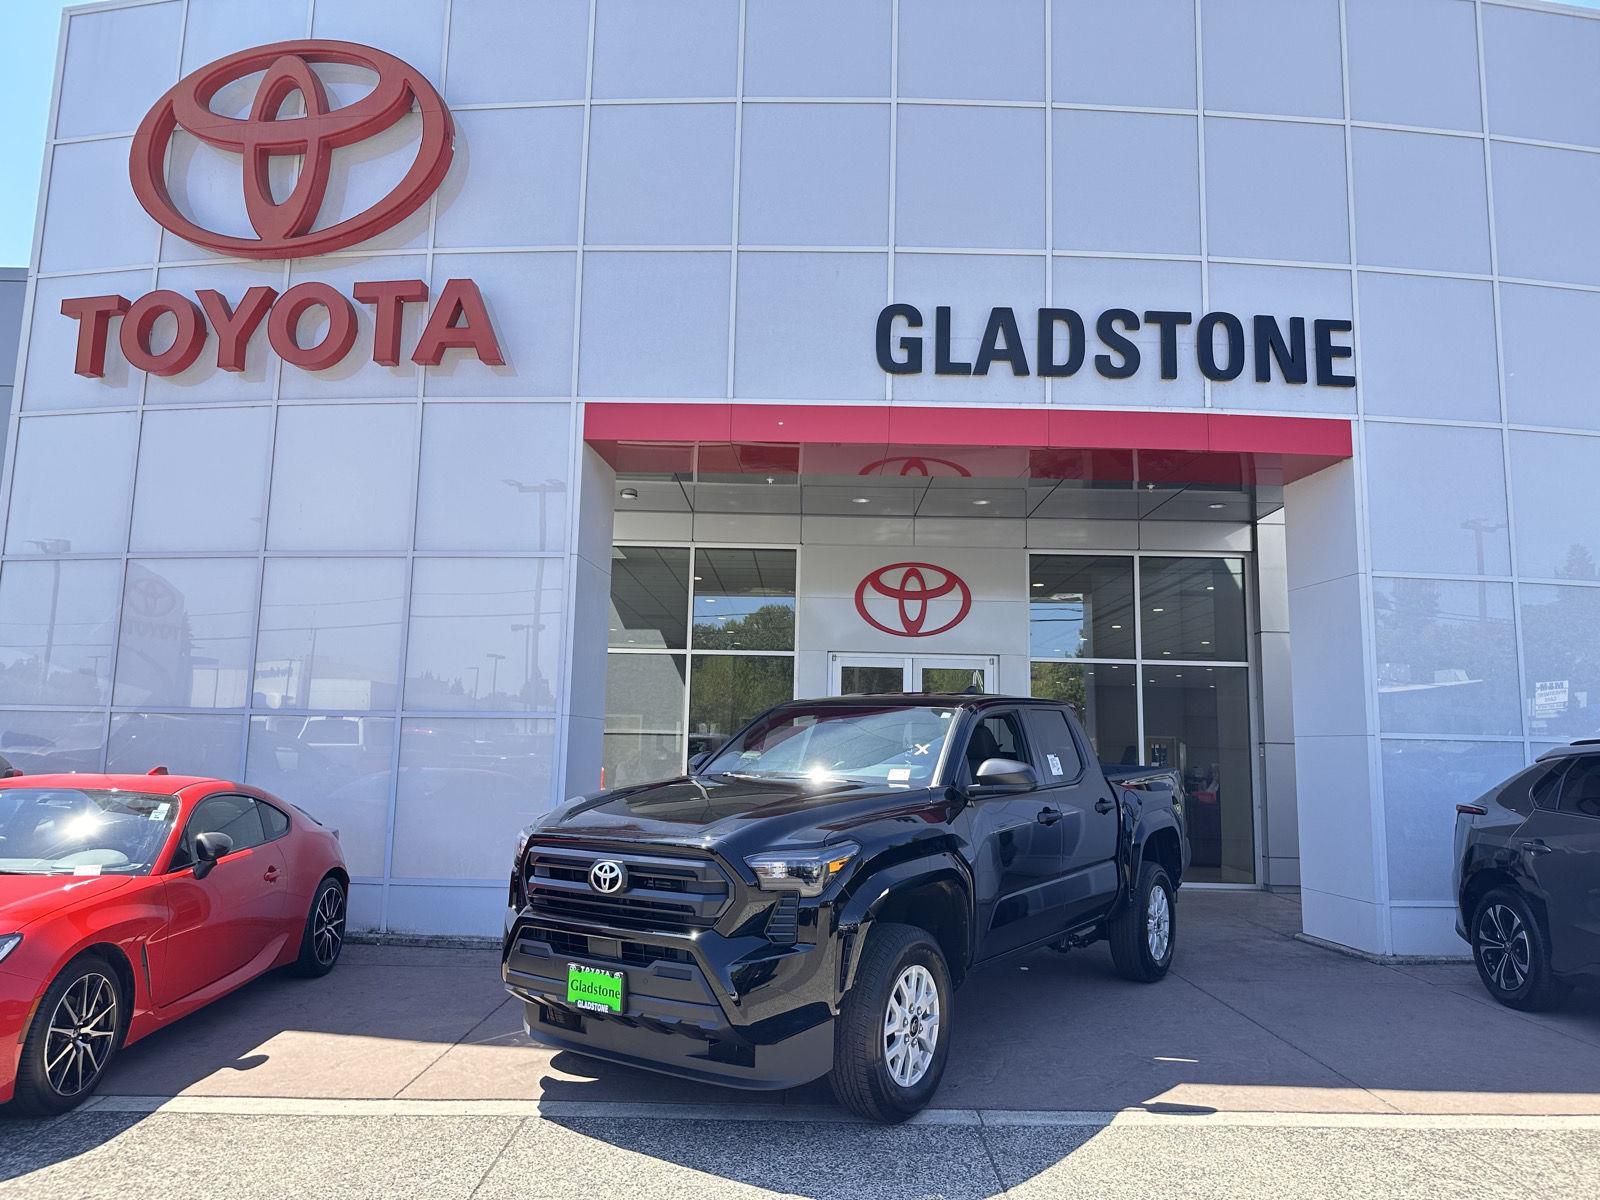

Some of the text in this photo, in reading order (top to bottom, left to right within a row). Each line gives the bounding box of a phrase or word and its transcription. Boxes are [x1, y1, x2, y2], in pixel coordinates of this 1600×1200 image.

[61, 279, 506, 378] TOYOTA
[875, 303, 1356, 388] GLADSTONE
[580, 966, 610, 976] TOYOTA
[570, 979, 621, 999] Gladstone
[577, 1000, 609, 1013] GLADSTONE
